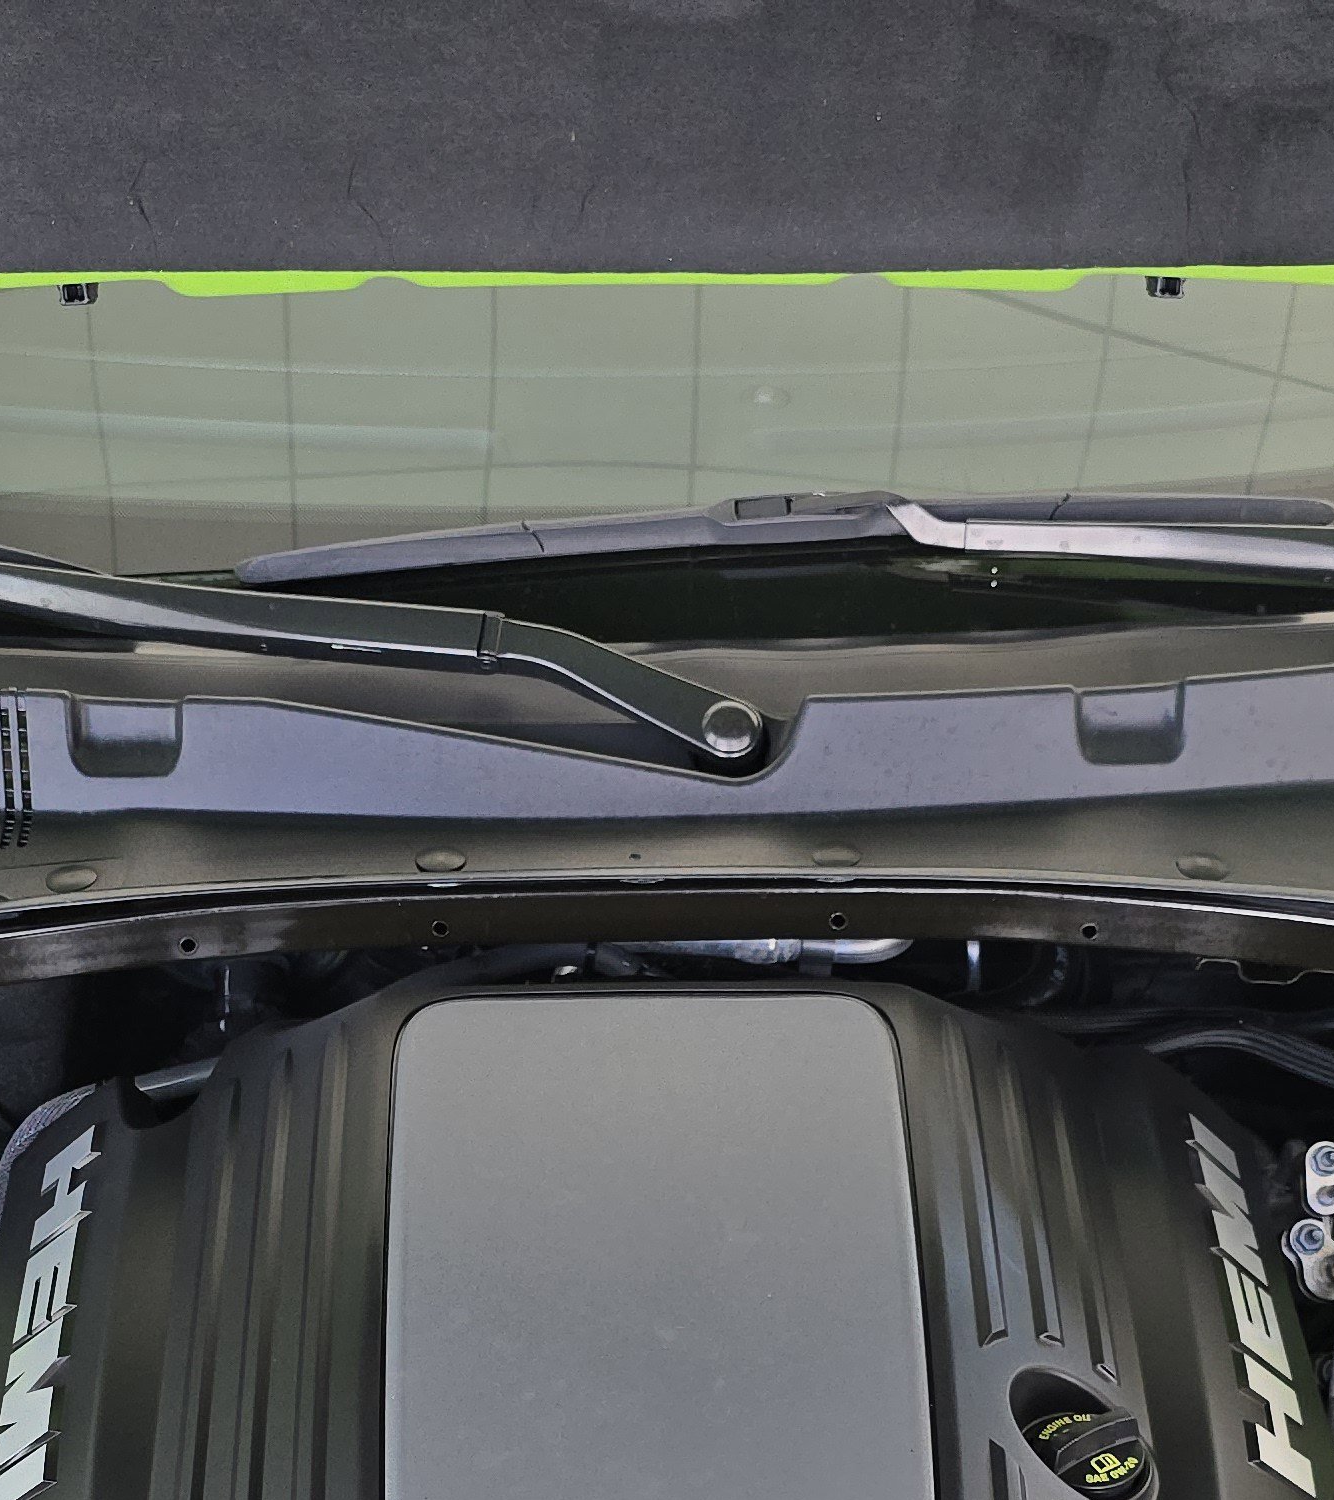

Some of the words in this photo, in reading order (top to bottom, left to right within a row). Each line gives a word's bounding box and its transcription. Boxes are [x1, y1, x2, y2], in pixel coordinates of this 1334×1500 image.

[1186, 1113, 1317, 1499] HEMI
[1039, 1416, 1073, 1440] ENGINE
[1085, 1473, 1110, 1484] SAE
